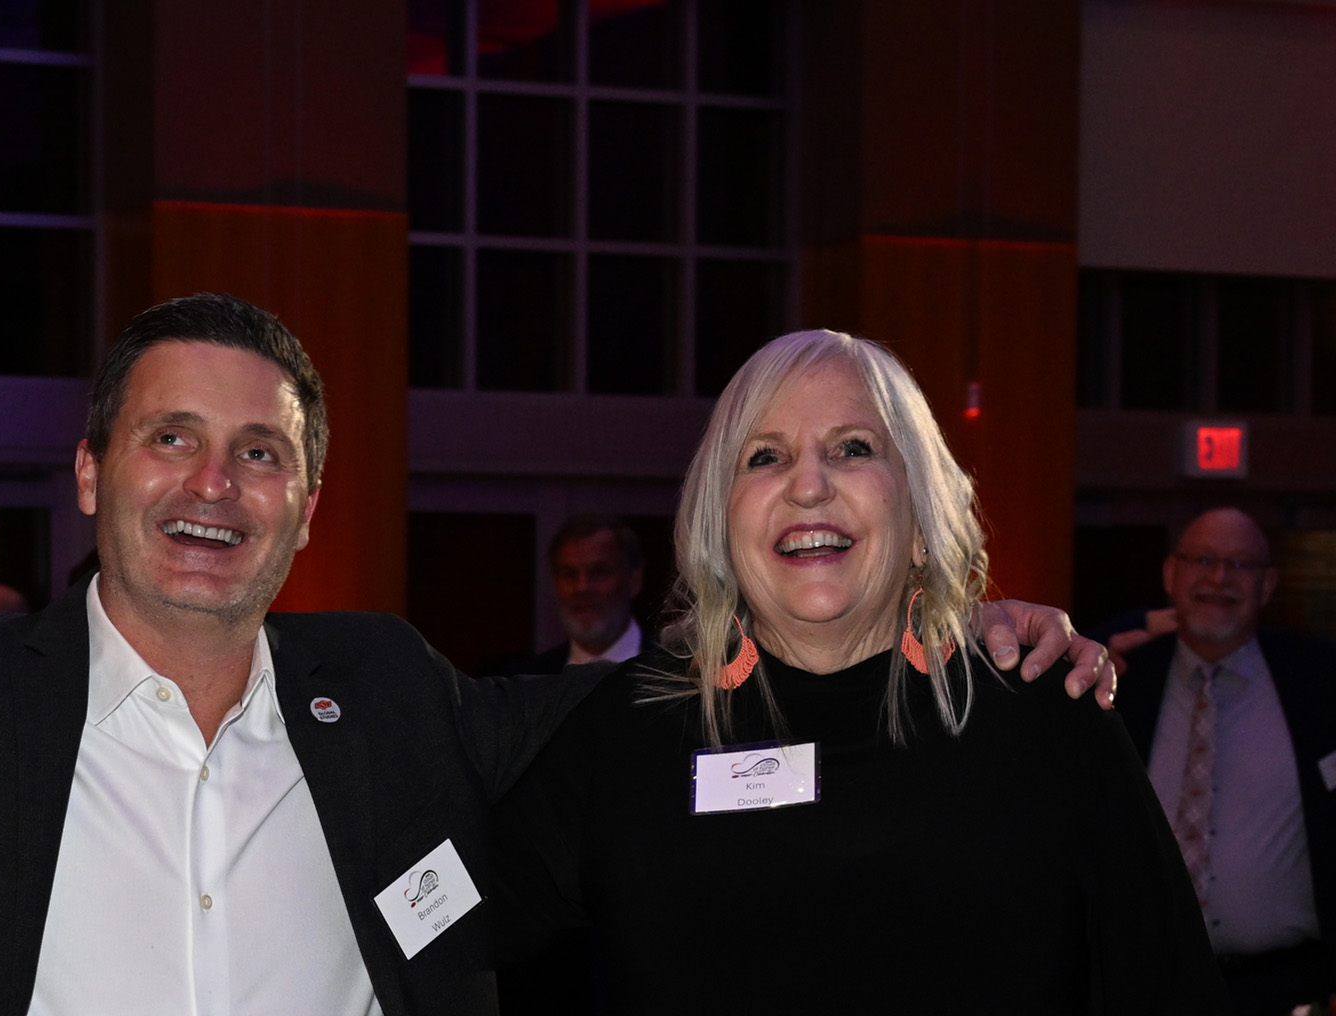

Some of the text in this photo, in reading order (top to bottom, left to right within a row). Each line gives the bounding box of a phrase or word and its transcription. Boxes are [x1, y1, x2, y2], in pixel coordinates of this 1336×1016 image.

[746, 782, 765, 790] Kim
[737, 797, 774, 807] Dooley
[417, 893, 449, 921] Brandon
[431, 914, 451, 932] Wulz
